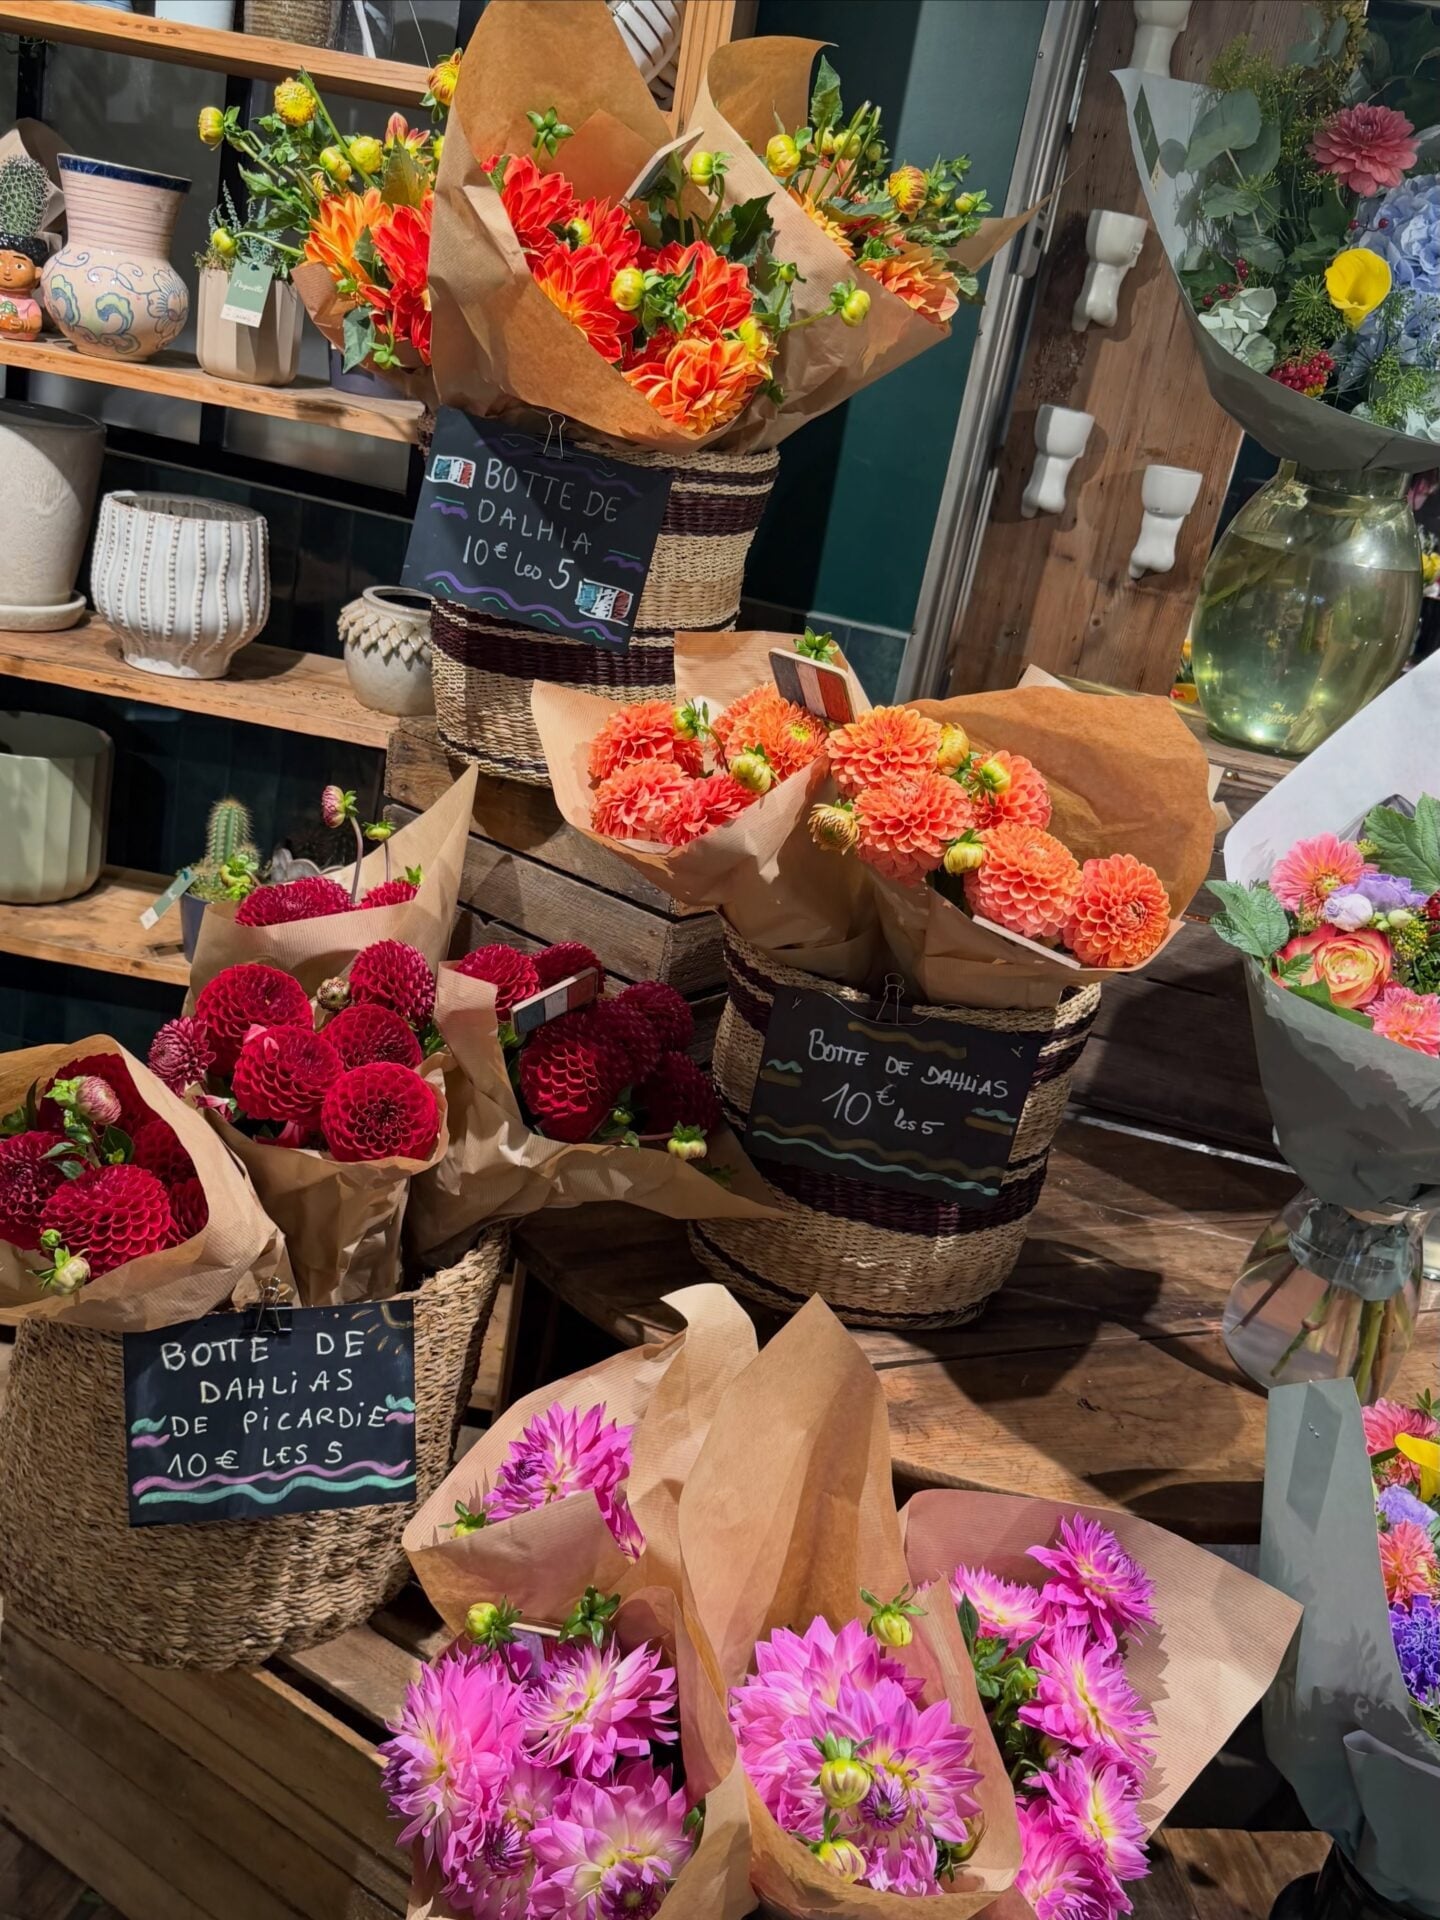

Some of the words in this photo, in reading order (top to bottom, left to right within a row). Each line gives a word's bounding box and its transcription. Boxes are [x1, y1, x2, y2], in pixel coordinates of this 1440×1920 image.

[484, 457, 576, 511] BOTTE
[583, 491, 622, 523] DE
[477, 499, 592, 555] DALHIA
[548, 558, 576, 590] 5
[885, 1055, 914, 1077] DE
[894, 1107, 916, 1131] les
[921, 1120, 945, 1136] 5
[160, 1336, 270, 1372] BOTTE
[315, 1330, 366, 1359] DE
[170, 1415, 209, 1438] DE
[262, 1443, 309, 1468] LES
